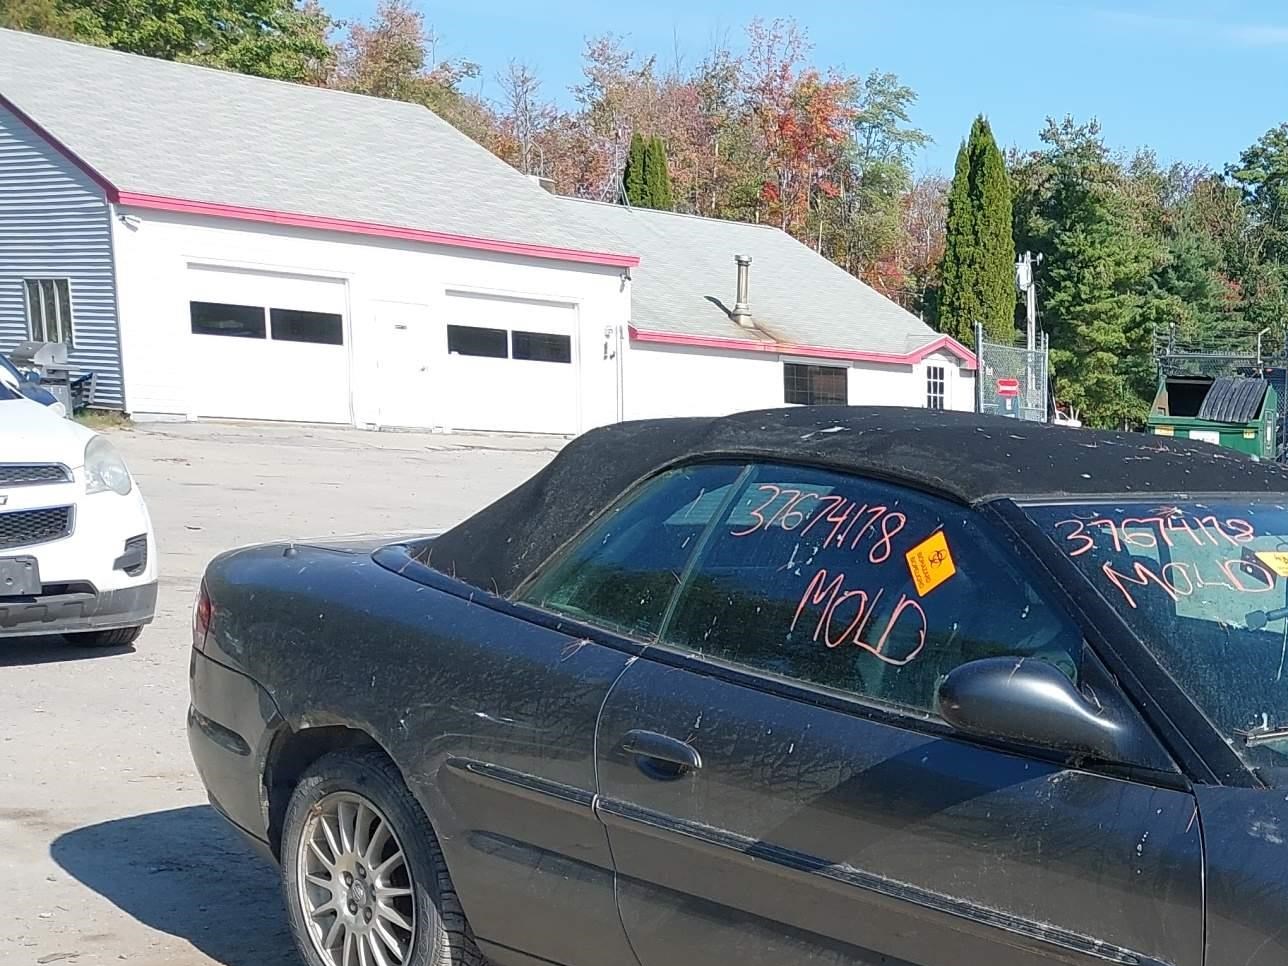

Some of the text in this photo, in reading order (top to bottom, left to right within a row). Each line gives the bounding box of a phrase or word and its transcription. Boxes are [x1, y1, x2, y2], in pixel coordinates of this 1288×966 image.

[730, 484, 907, 564] 37674178
[1055, 516, 1255, 556] 37674178
[1102, 559, 1275, 609] MOLD
[789, 568, 928, 666] MOLD
